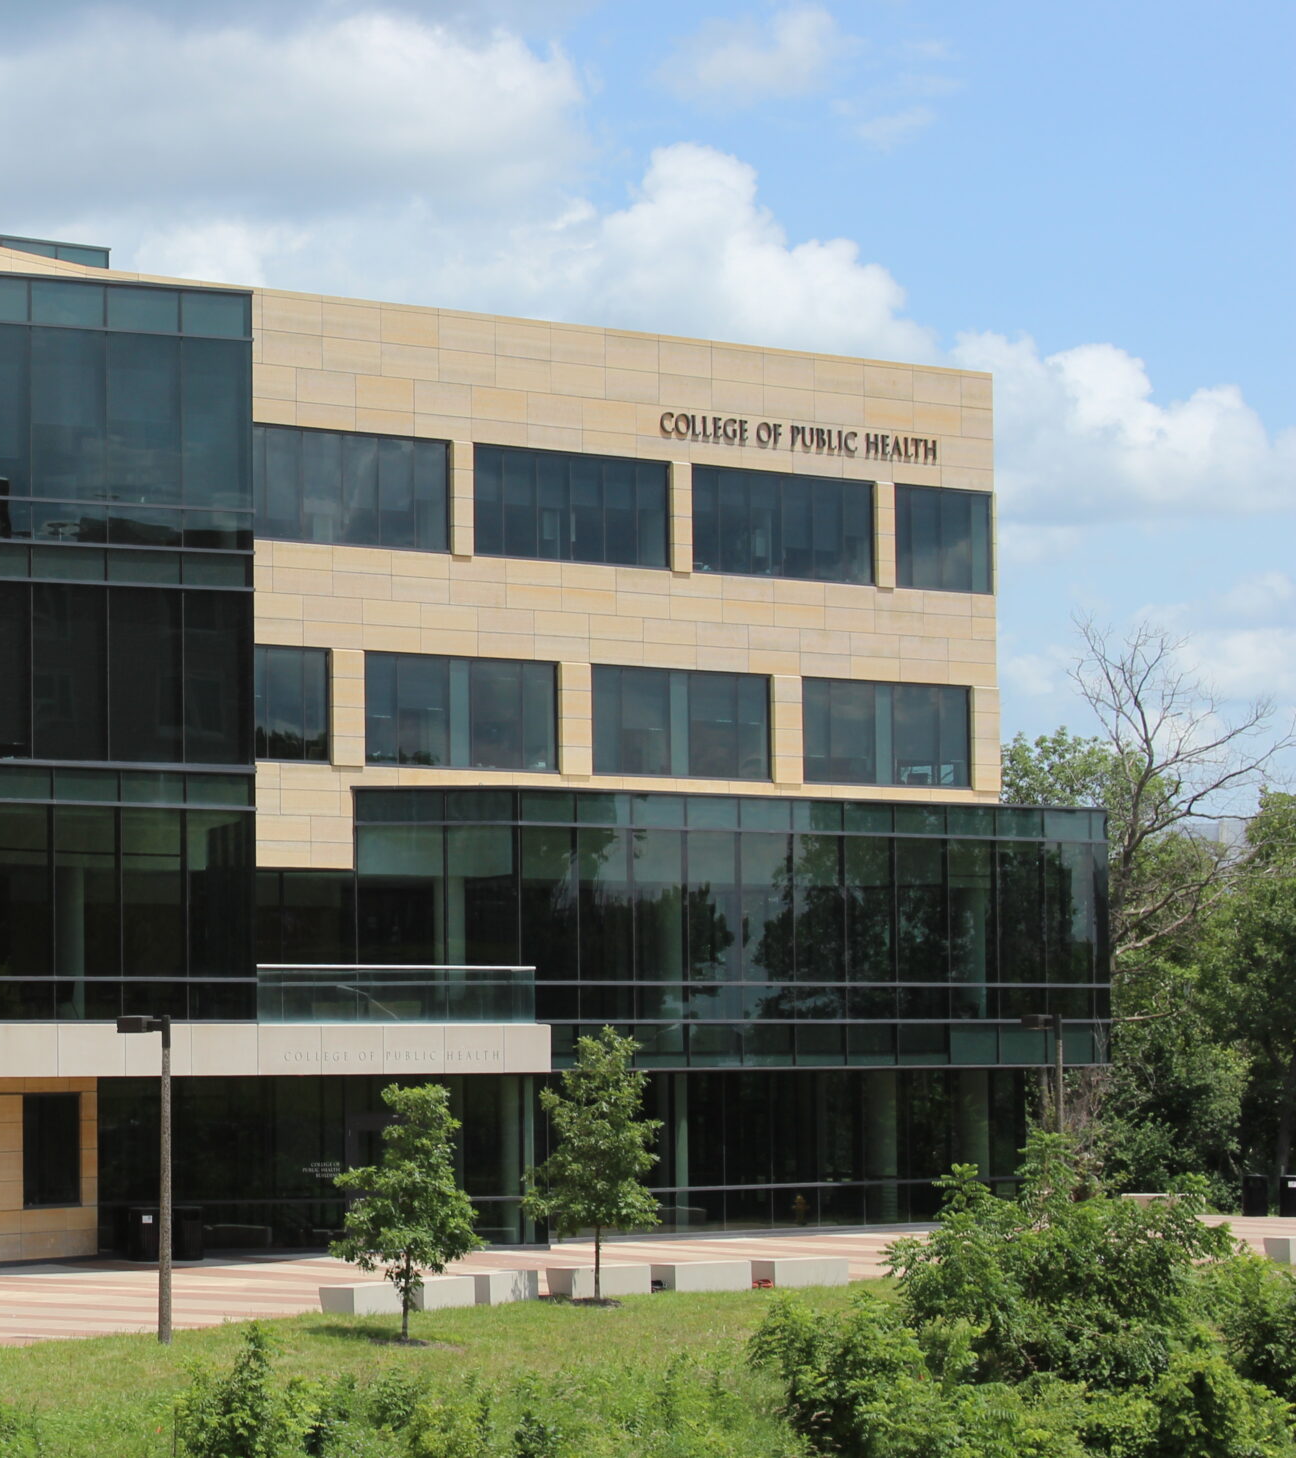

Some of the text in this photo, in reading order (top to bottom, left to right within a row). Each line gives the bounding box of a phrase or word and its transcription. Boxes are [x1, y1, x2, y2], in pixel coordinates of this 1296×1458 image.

[659, 411, 938, 461] COLLEGE OF PUBLIC HEALTH
[283, 1049, 501, 1062] COLLEGE OF PUBLIC HEALTH
